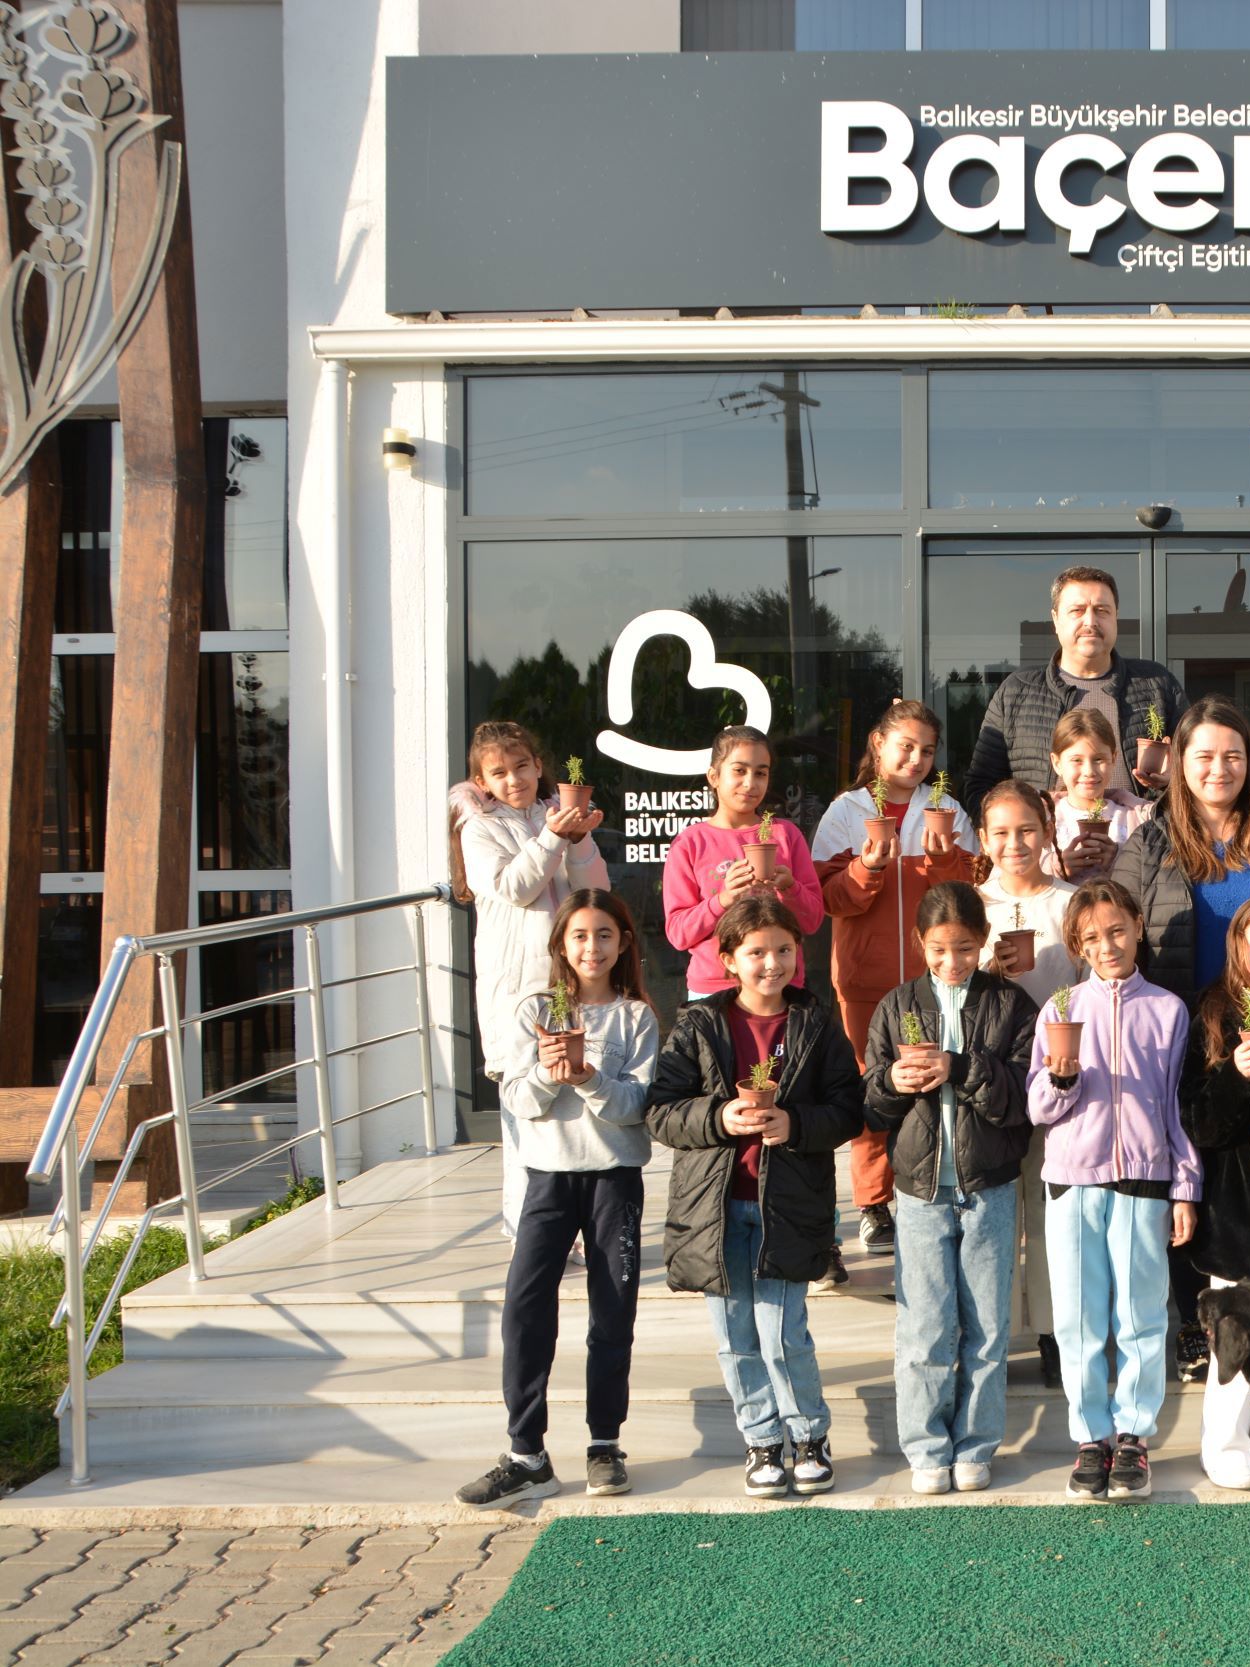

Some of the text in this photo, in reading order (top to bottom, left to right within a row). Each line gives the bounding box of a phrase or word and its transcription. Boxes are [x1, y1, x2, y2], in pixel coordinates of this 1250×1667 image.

[920, 104, 1024, 127] Balıkesir
[1030, 104, 1168, 132] Büyükşehir
[1117, 244, 1184, 273] Çiftçi
[625, 812, 710, 837] BÜYÜK
[626, 843, 671, 863] BELE
